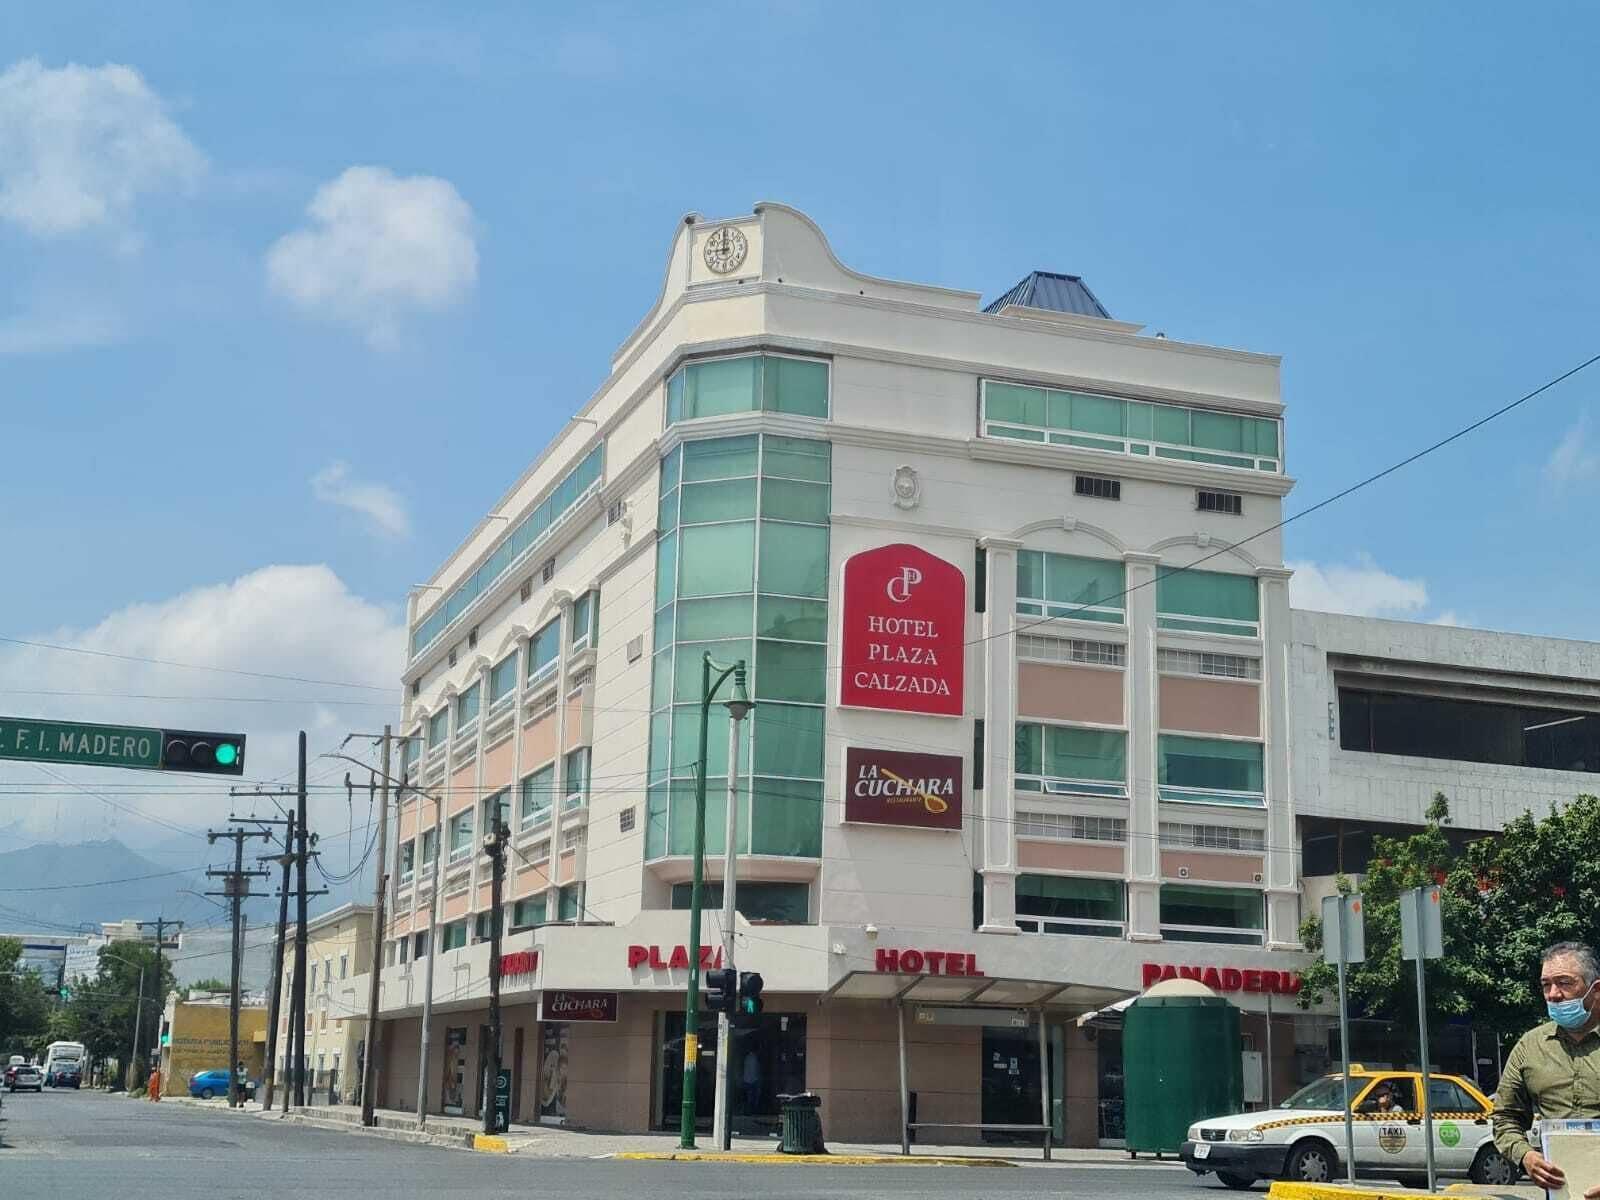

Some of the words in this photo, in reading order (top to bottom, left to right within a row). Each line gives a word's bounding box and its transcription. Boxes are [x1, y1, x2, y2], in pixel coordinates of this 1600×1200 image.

[868, 616, 938, 638] HOTEL
[868, 644, 938, 666] PLAZA
[854, 671, 950, 696] CALZADA
[16, 729, 29, 749] F.
[38, 730, 50, 751] I.
[58, 732, 150, 758] MADERO
[858, 764, 878, 778] LA
[854, 778, 954, 797] CUCHARA
[875, 949, 985, 976] HOTEL
[551, 999, 608, 1012] CUCHARA
[1383, 1127, 1403, 1135] TAXI
